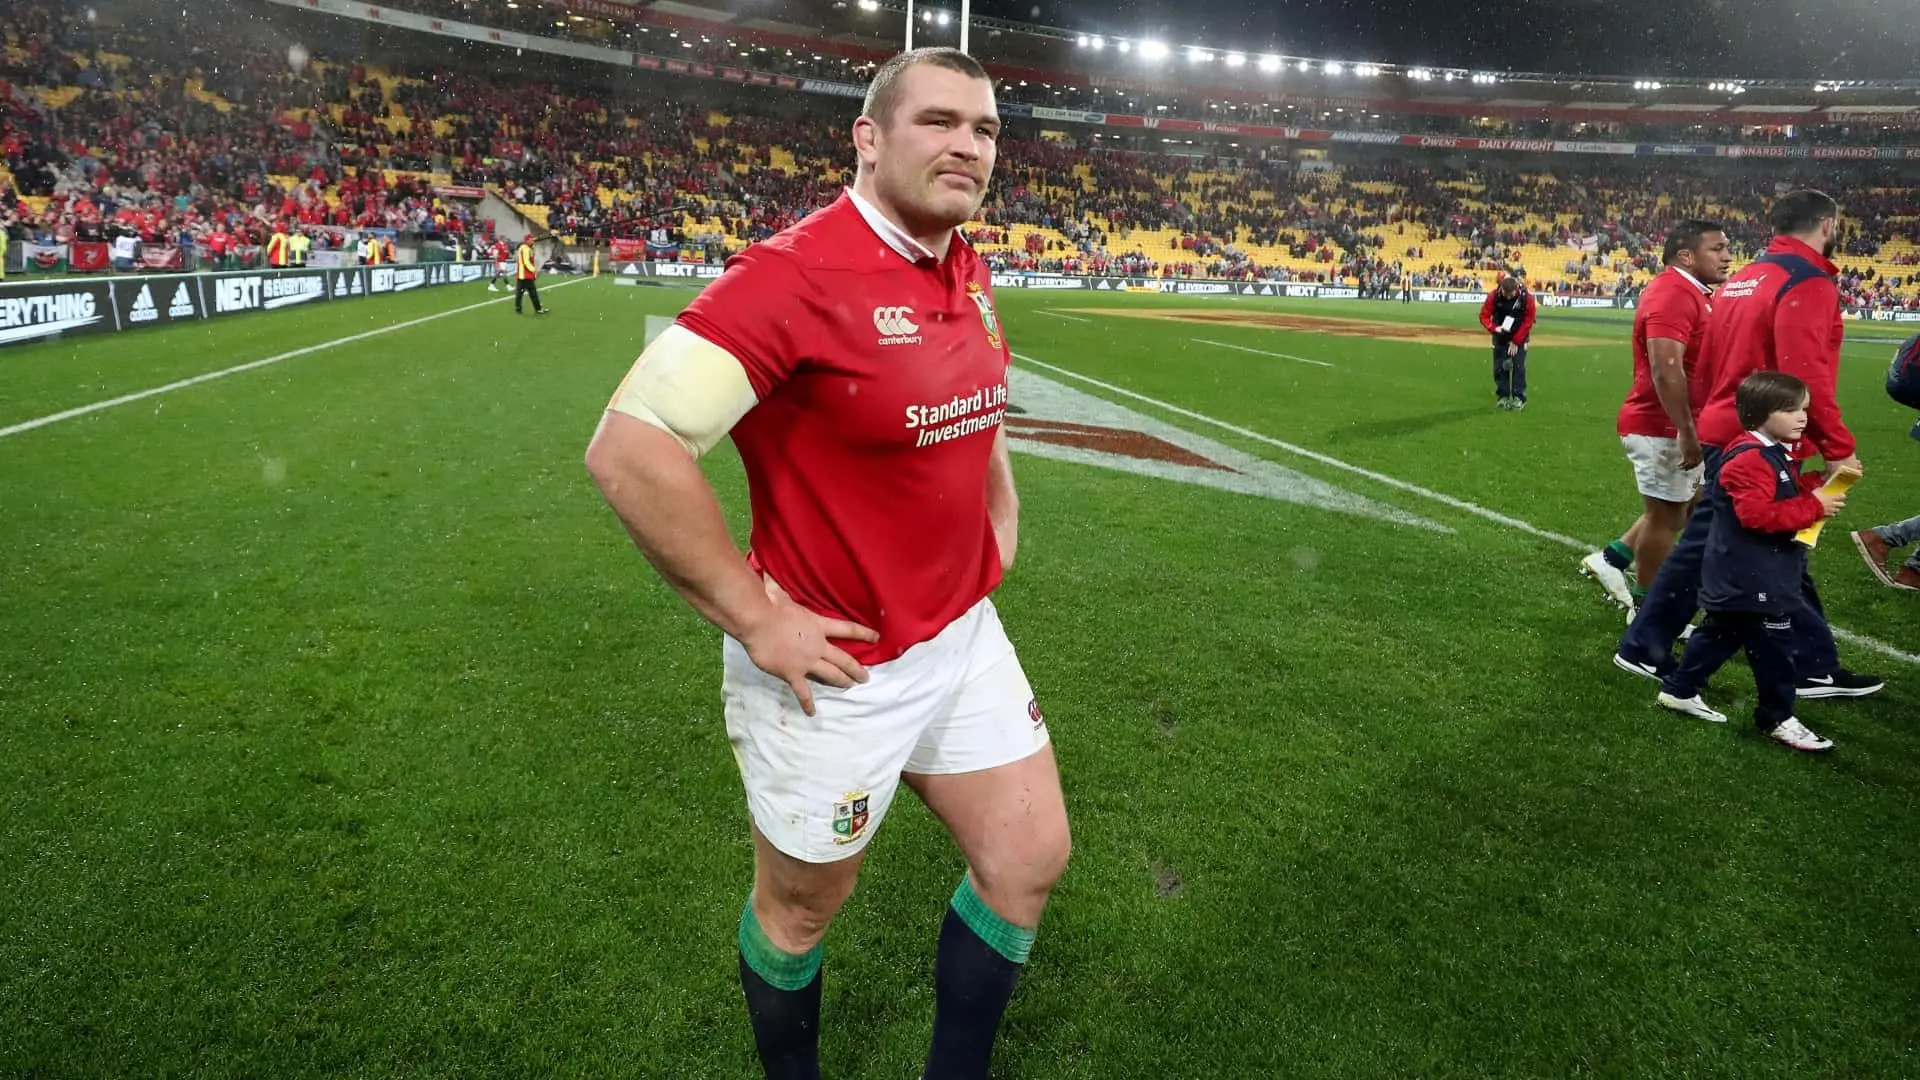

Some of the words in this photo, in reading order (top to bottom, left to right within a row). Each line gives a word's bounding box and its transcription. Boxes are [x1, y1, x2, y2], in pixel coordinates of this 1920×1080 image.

[1331, 131, 1400, 144] MAINFREIGHT
[1421, 137, 1456, 148] OWENS
[1478, 139, 1508, 149] DAILY
[1510, 140, 1553, 151] FREIGHT
[1728, 146, 1785, 158] KENNARDS
[1814, 147, 1873, 159] KENNARDS
[656, 264, 695, 276] NEXT
[991, 275, 1025, 287] NEXT
[216, 276, 261, 312] NEXT
[273, 276, 322, 296] EVERYTHING
[1286, 286, 1316, 297] NEXT
[1419, 290, 1447, 301] NEXT
[878, 334, 922, 346] canterbury
[905, 389, 982, 429] Standard
[985, 383, 1007, 408] Life
[916, 407, 1005, 447] Investments
